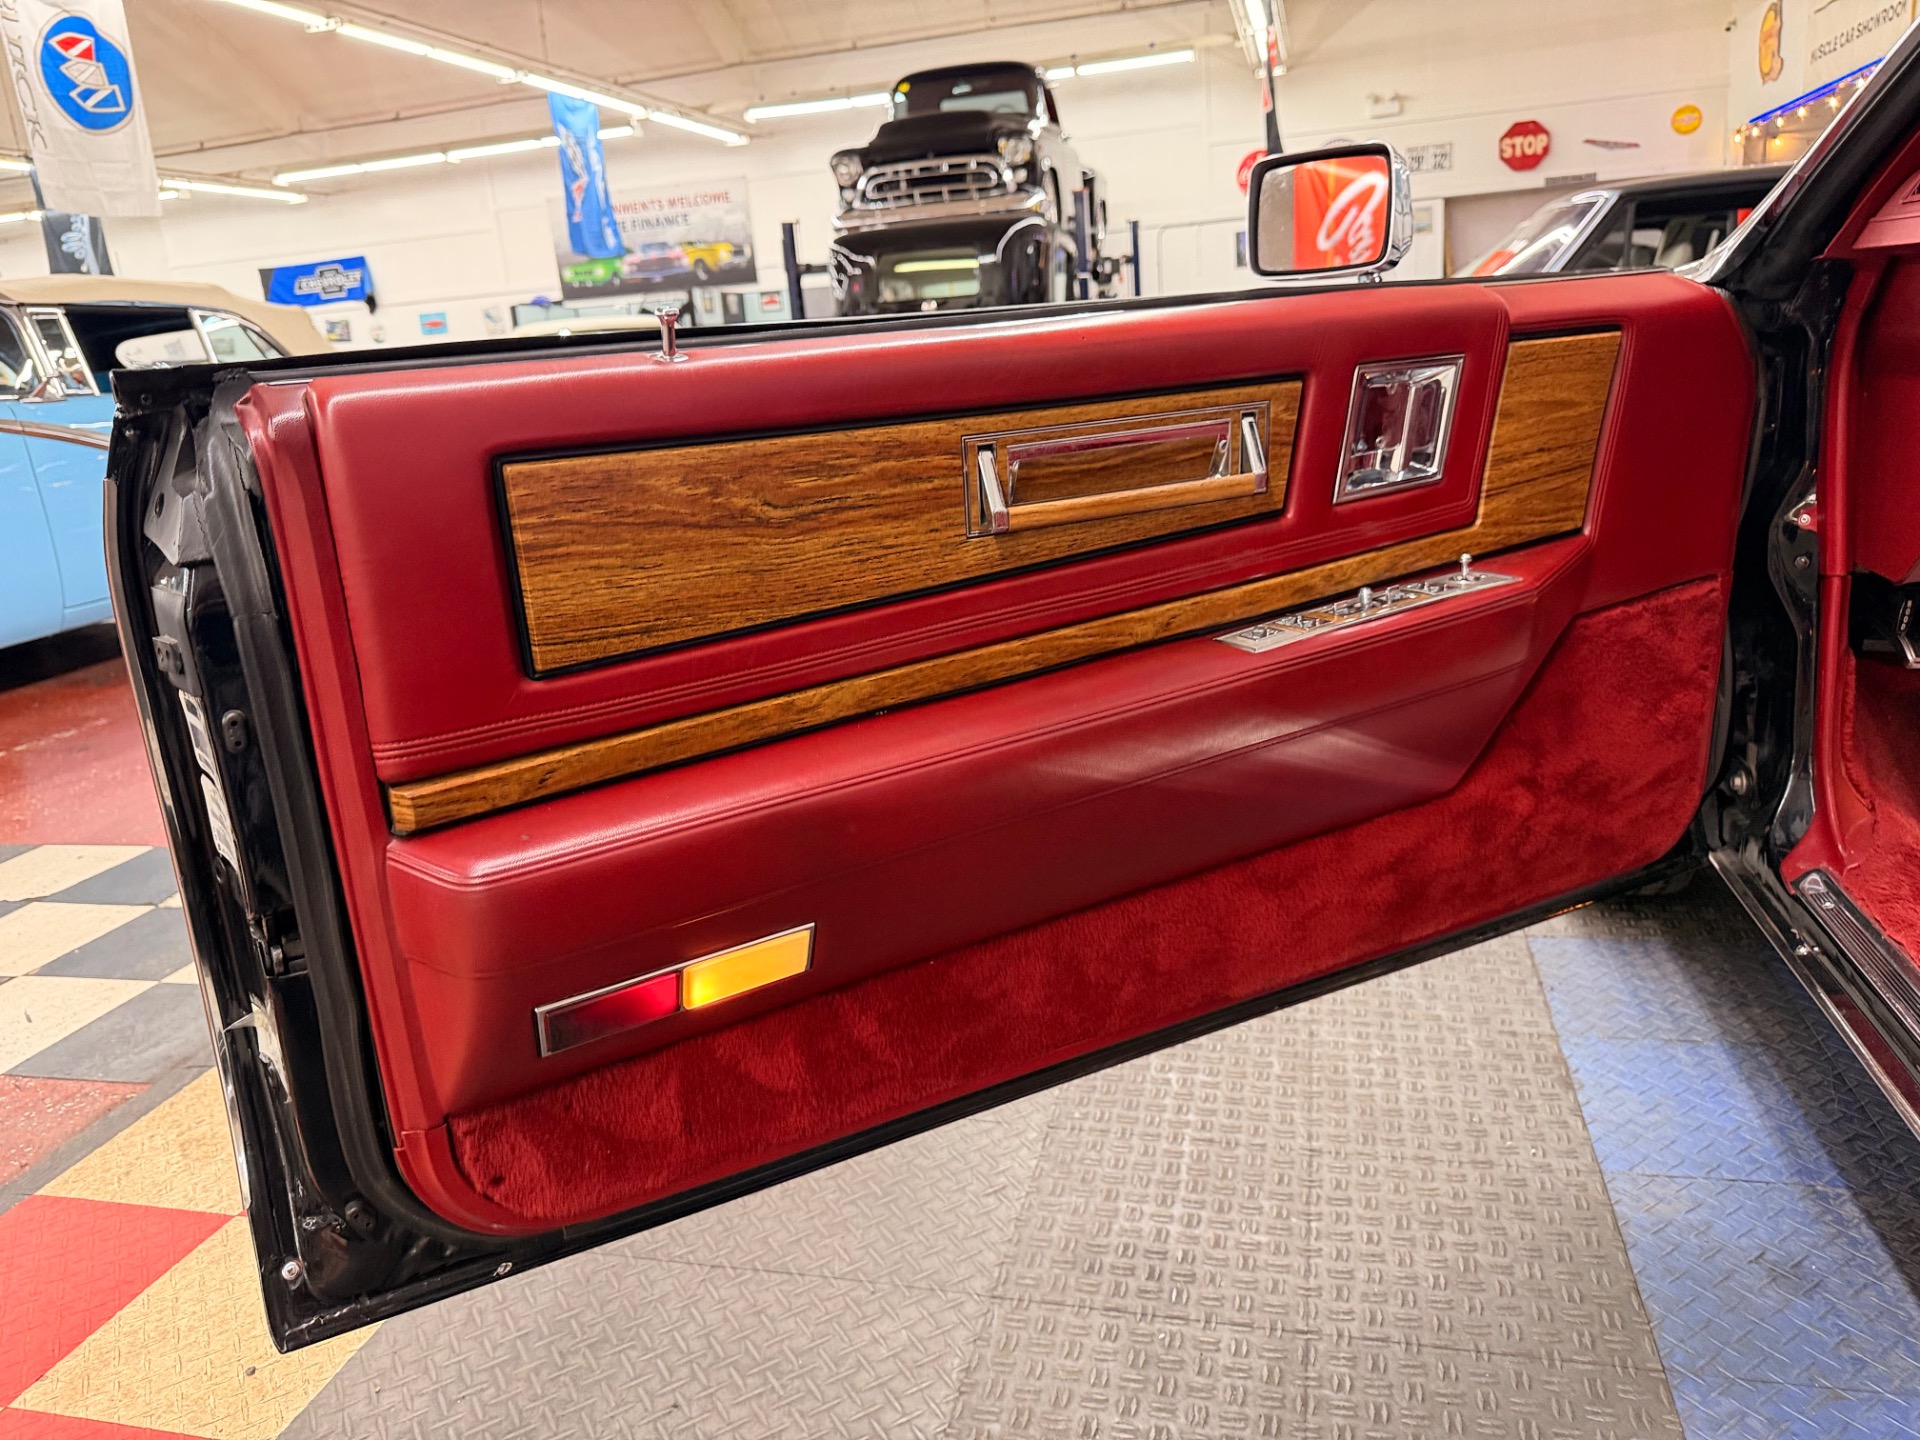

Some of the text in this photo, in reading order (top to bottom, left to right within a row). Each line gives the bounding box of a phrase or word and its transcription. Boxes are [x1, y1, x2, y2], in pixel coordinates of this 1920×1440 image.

[1501, 133, 1548, 159] STOP
[667, 191, 730, 209] WELCOME
[631, 213, 691, 232] FINANCE
